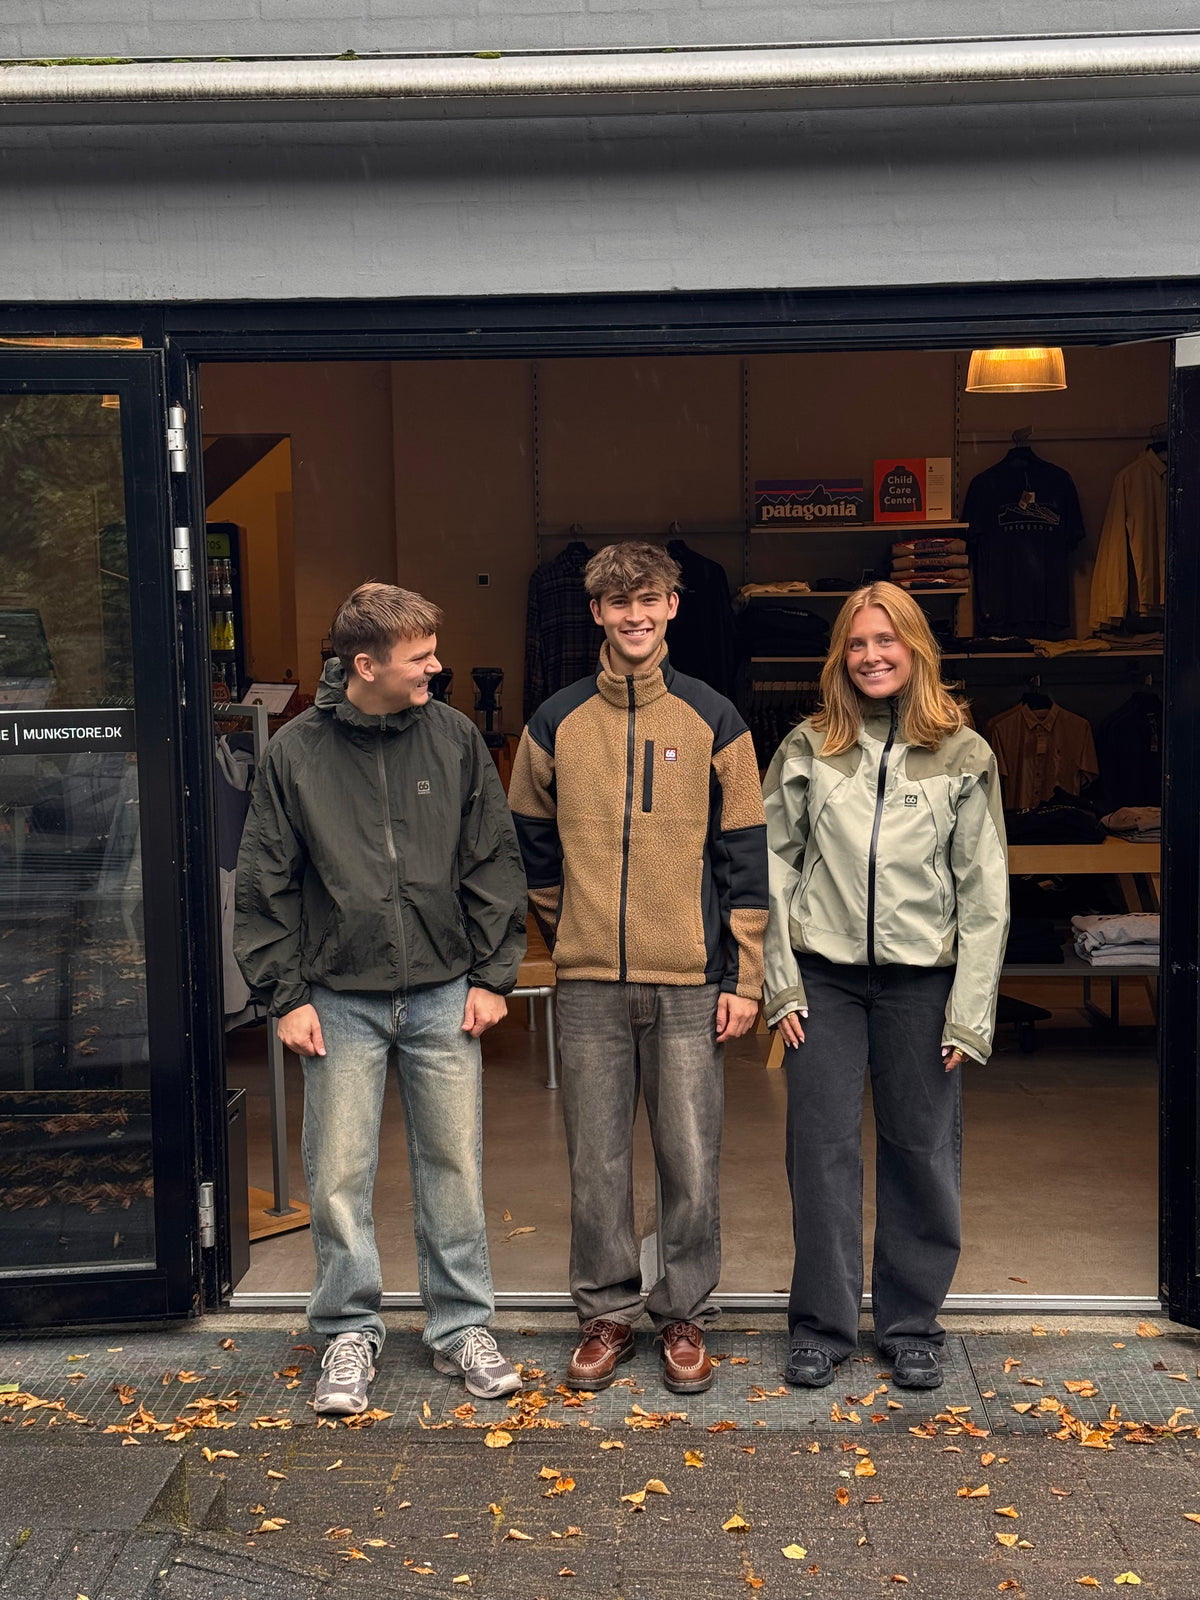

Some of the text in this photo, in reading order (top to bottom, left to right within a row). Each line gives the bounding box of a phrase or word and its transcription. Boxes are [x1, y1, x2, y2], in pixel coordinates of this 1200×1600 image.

[888, 475, 912, 484] Child
[889, 486, 911, 494] Care
[884, 496, 916, 504] Center
[761, 501, 857, 521] patagonia
[0, 726, 122, 741] E MUNKSTORE.DK
